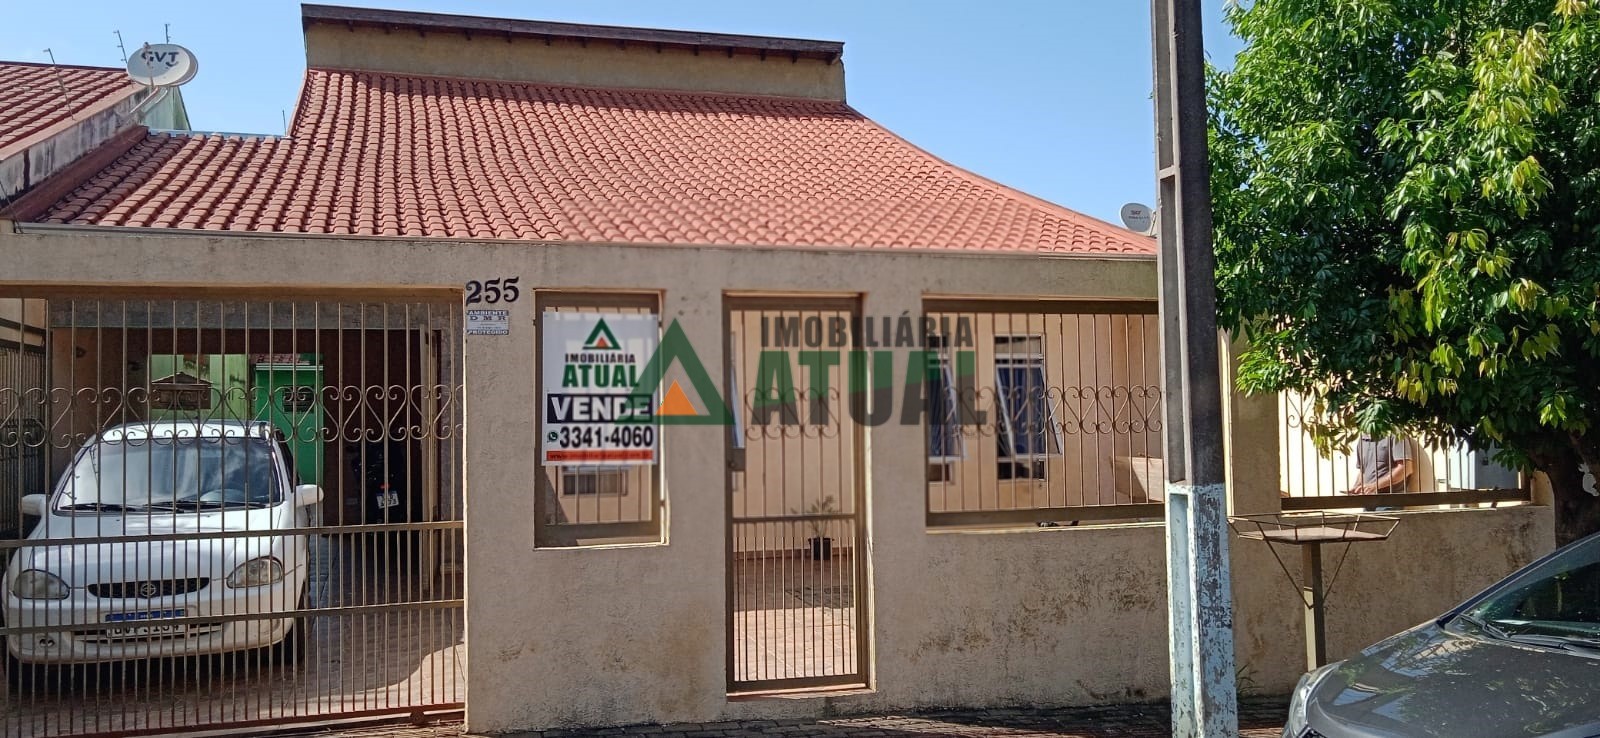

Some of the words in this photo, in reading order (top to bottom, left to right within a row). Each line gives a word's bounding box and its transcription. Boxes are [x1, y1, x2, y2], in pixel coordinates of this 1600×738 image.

[465, 276, 520, 306] 255
[565, 352, 636, 363] IMOBILIÁRIA
[562, 364, 640, 388] ATUAL
[550, 396, 650, 421] VENDE
[559, 426, 654, 448] 3341-4060
